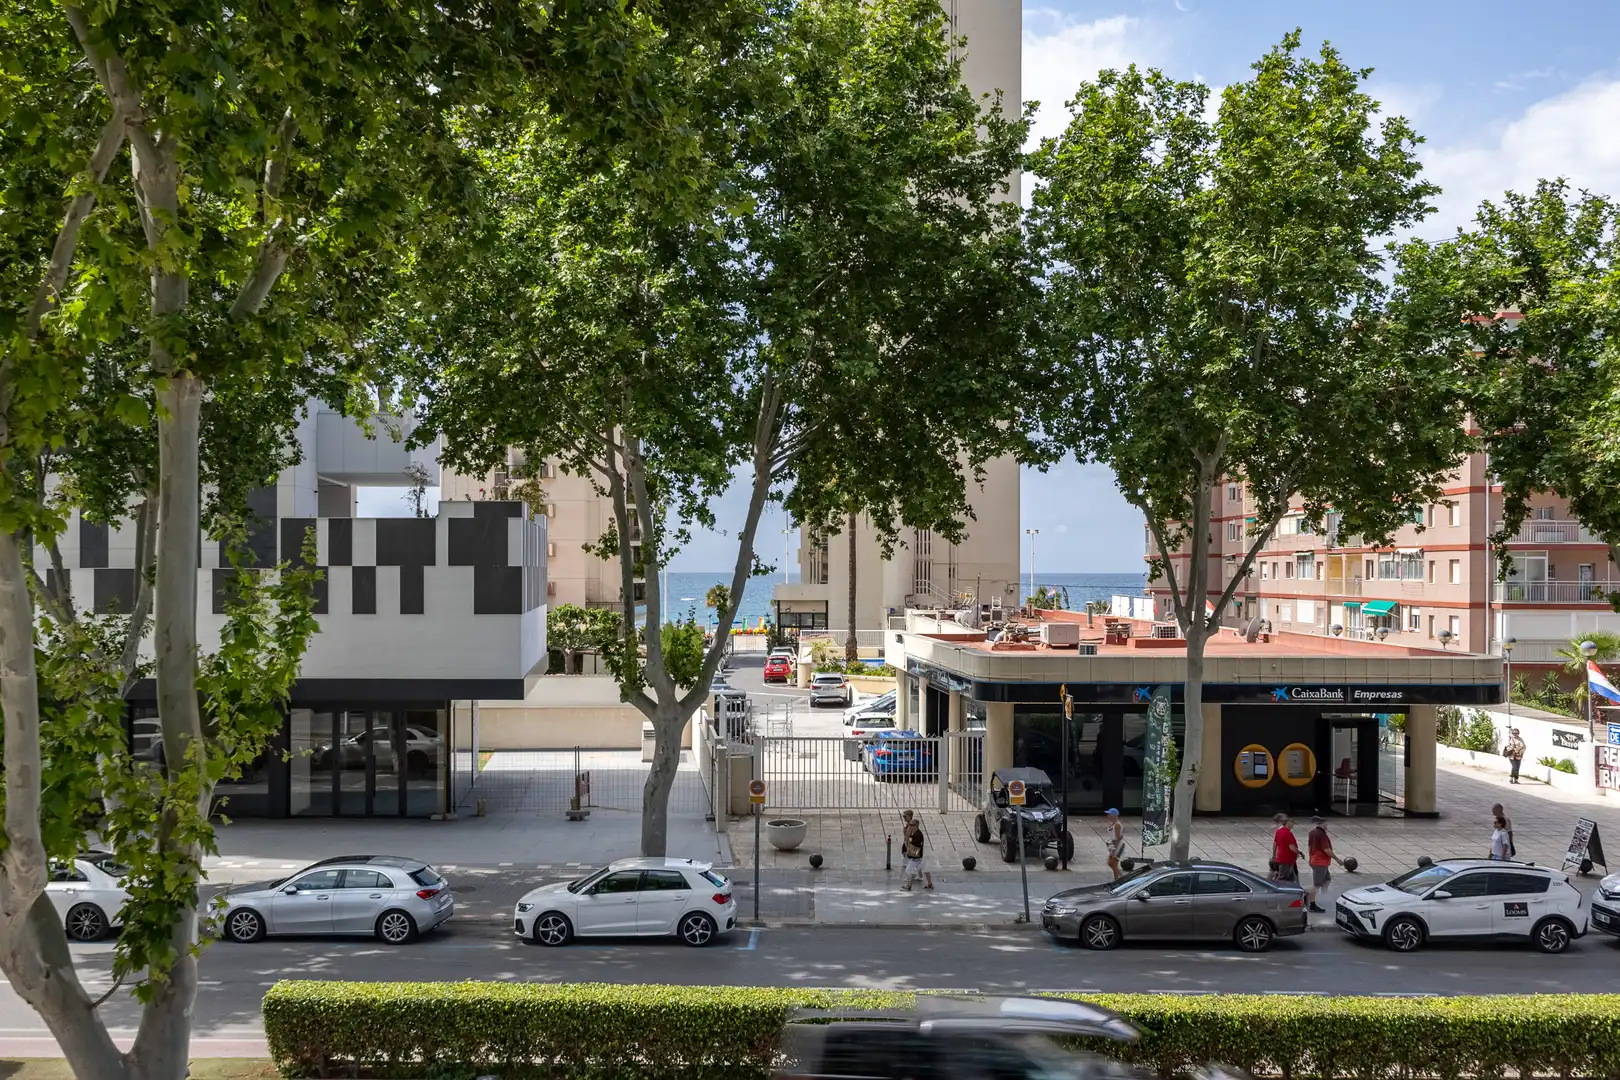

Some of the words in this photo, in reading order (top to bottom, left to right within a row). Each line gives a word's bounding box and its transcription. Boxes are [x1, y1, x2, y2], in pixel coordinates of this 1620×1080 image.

[1291, 686, 1344, 699] CaixaBank
[1354, 689, 1403, 700] Empresas
[1599, 747, 1620, 768] RE
